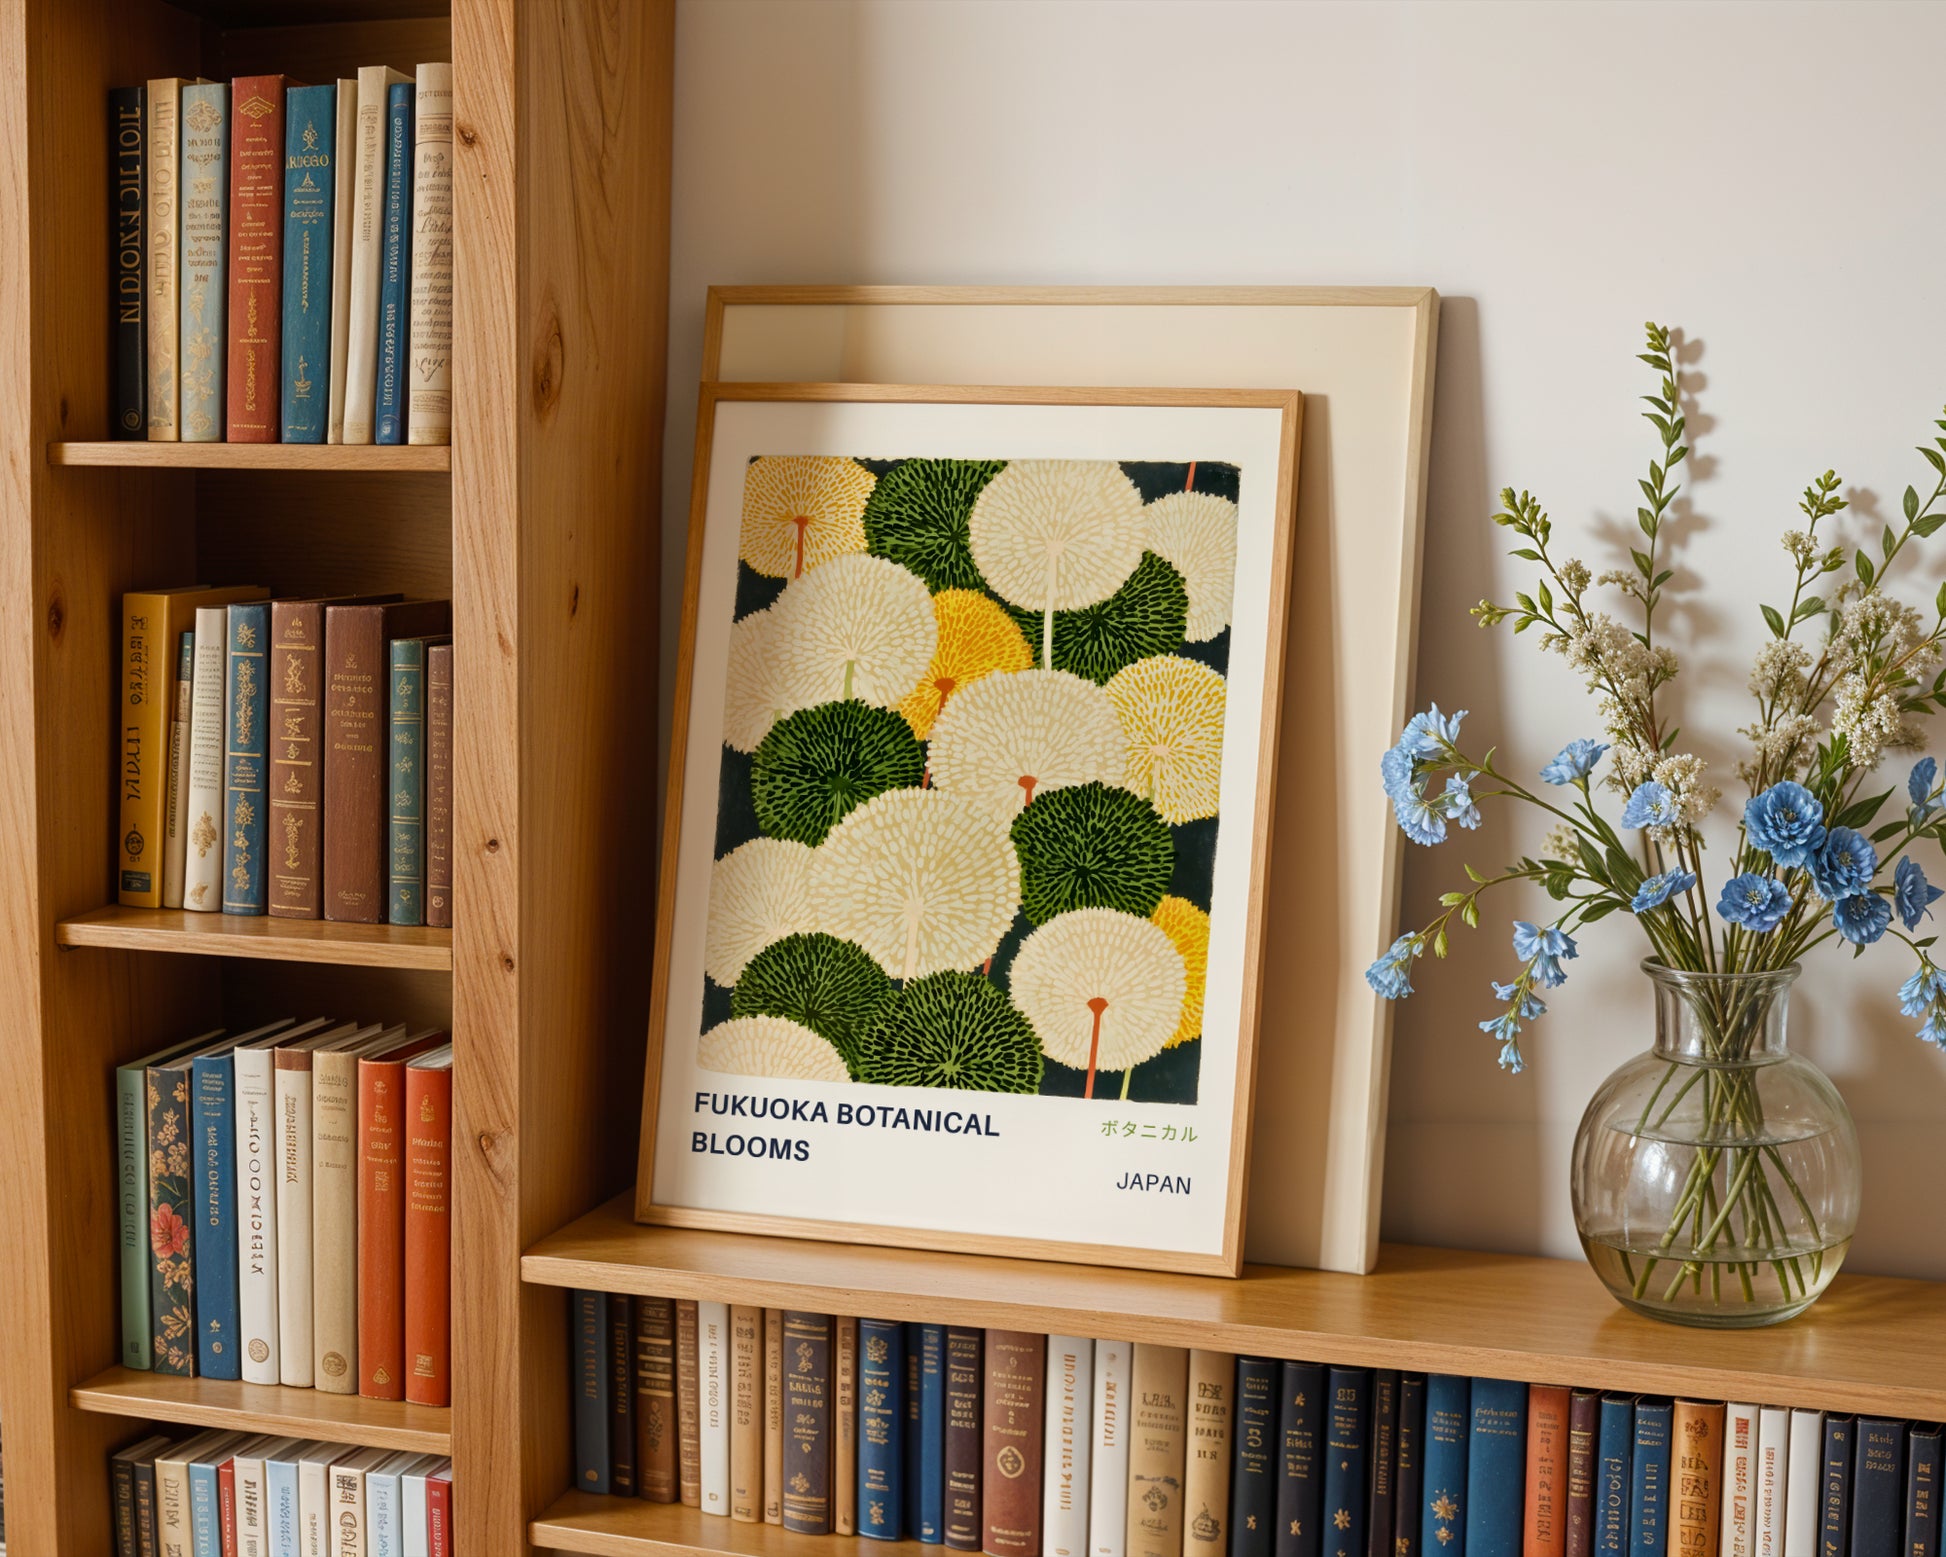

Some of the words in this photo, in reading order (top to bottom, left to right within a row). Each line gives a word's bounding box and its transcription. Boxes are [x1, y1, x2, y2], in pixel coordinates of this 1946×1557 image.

[694, 1092, 829, 1125] FUKUOKA
[836, 1103, 1001, 1137] BOTANICAL
[1101, 1120, 1198, 1143] ボタニカル
[691, 1132, 810, 1162] BLOOMS
[1116, 1172, 1192, 1195] JAPAN
